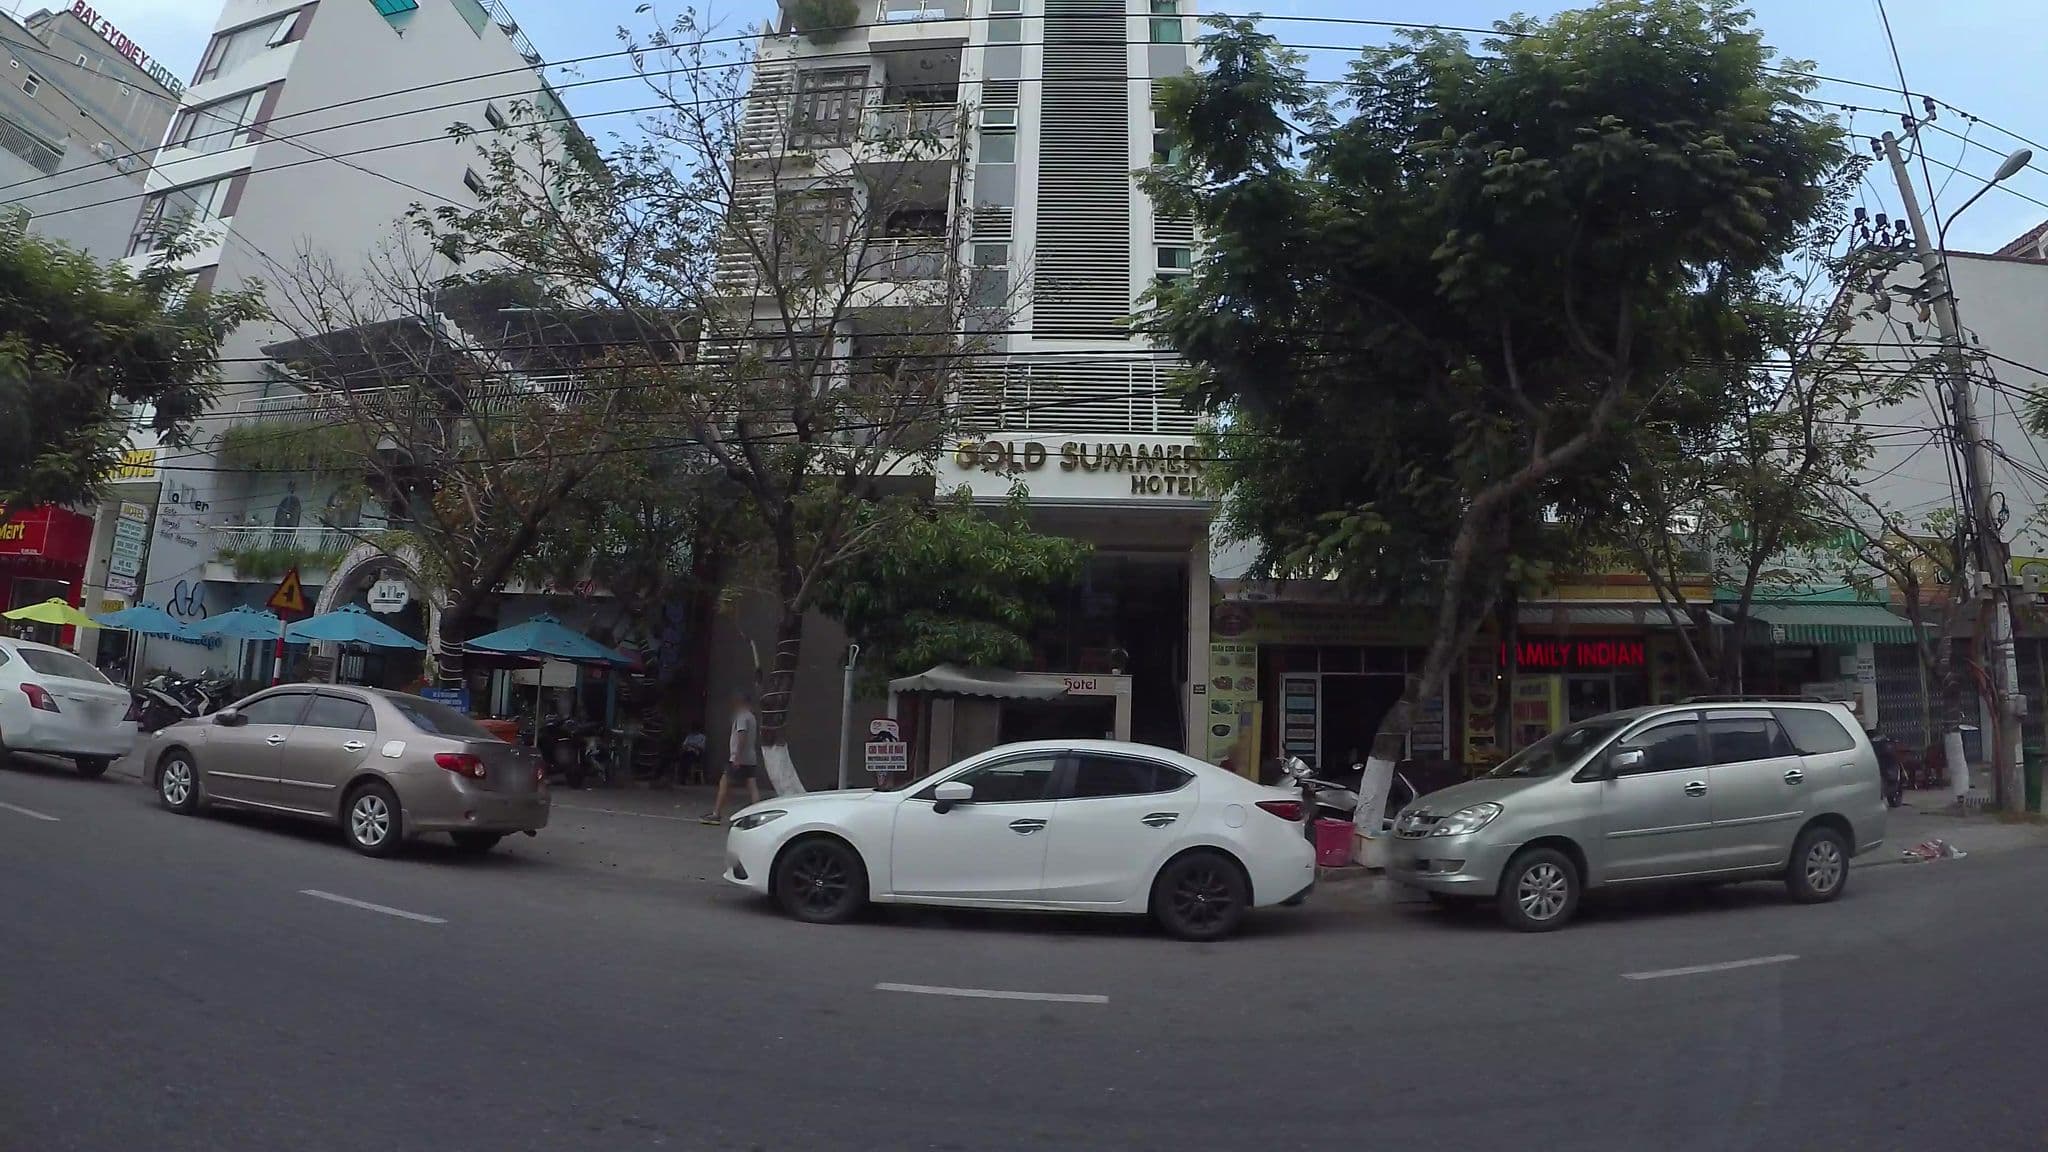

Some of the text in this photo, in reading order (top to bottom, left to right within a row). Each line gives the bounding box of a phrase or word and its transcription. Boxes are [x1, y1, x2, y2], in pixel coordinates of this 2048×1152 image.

[71, 0, 187, 98] BAY SYDNEY HOTEL
[955, 440, 1203, 473] GOLD SUMMER
[1131, 475, 1203, 496] HOTEL
[1577, 639, 1645, 667] INDIAN
